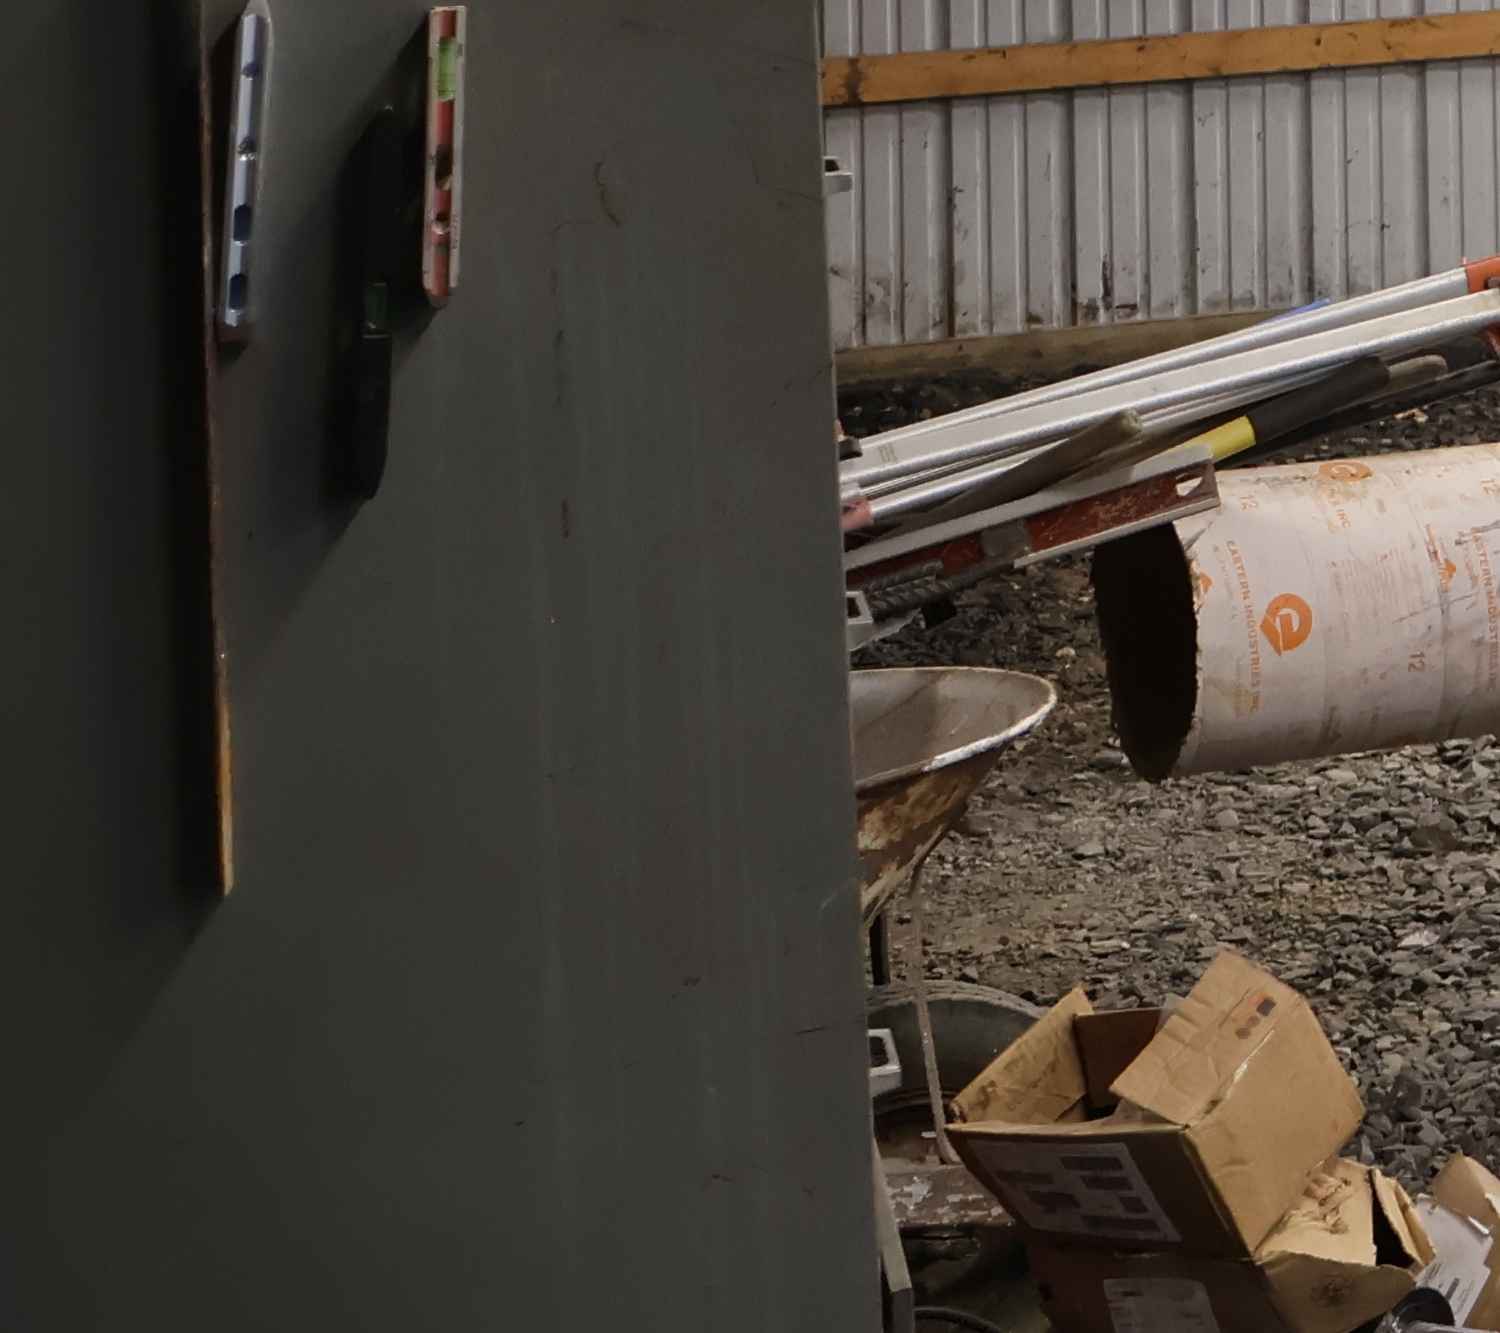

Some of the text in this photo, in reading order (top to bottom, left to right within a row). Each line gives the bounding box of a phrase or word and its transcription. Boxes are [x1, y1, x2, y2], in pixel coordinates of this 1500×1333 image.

[1238, 494, 1259, 511] 12
[1226, 539, 1251, 602] EASTERN
[1243, 605, 1262, 687] INDUSTRIES
[1406, 651, 1426, 674] 12
